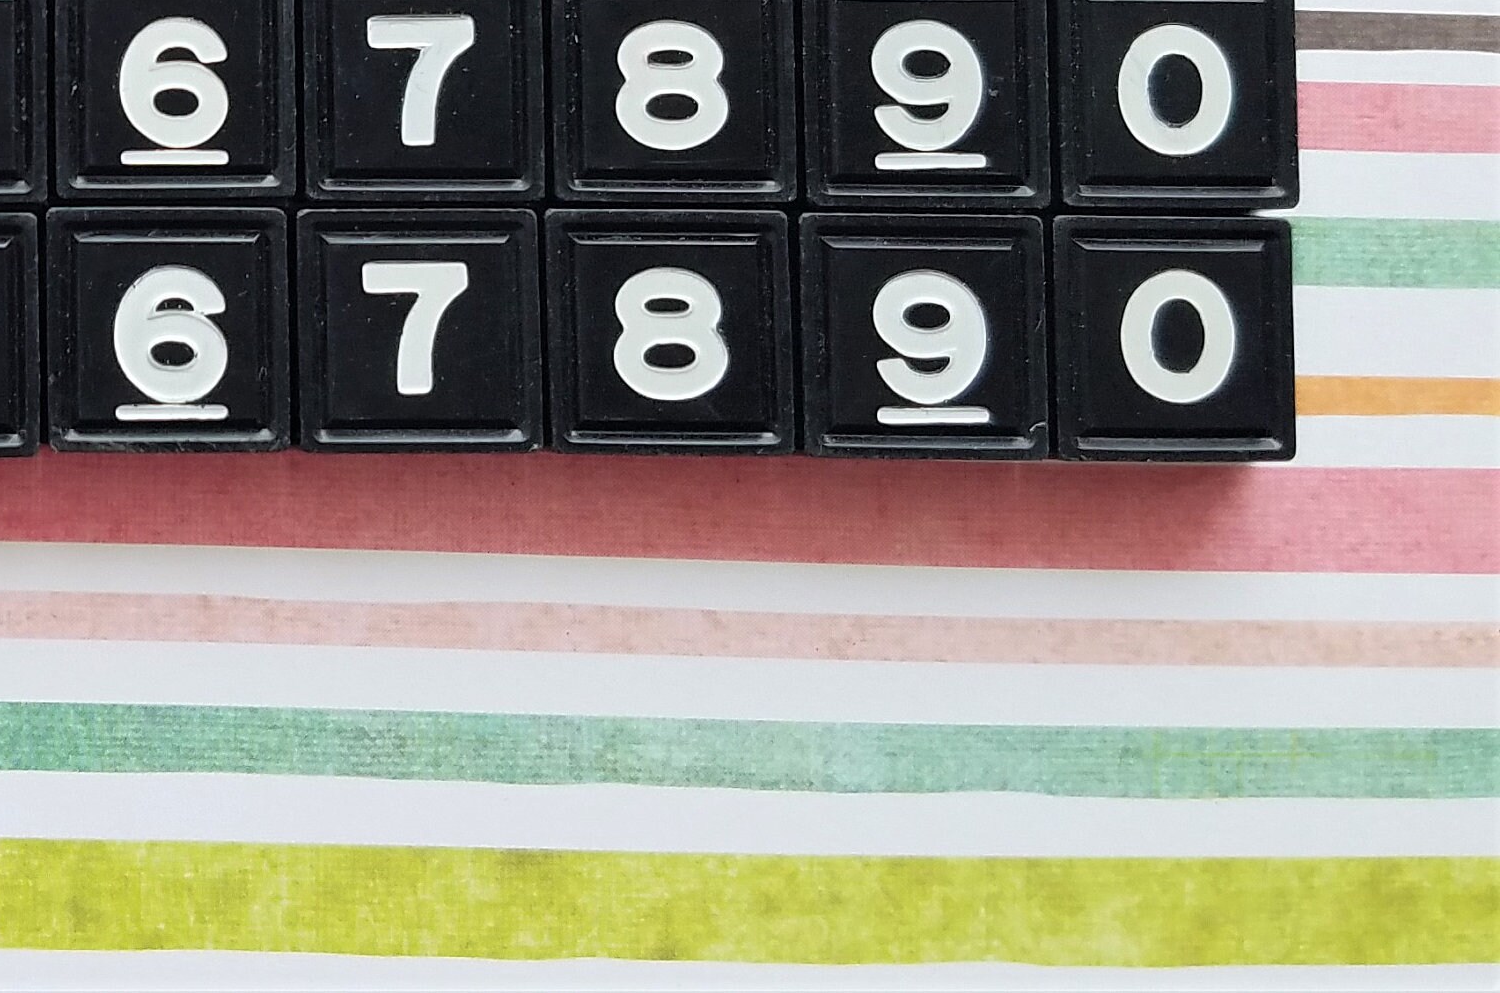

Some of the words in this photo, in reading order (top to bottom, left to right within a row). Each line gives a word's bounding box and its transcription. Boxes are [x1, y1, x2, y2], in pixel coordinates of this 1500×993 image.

[118, 17, 229, 149] 6
[366, 14, 475, 147] 7
[615, 19, 729, 151] 8
[871, 19, 984, 152] 9
[1117, 24, 1234, 156] 0
[113, 266, 229, 404] 6
[361, 261, 469, 395] 7
[613, 267, 729, 401] 8
[872, 270, 987, 405] 9
[1120, 269, 1237, 404] 0
